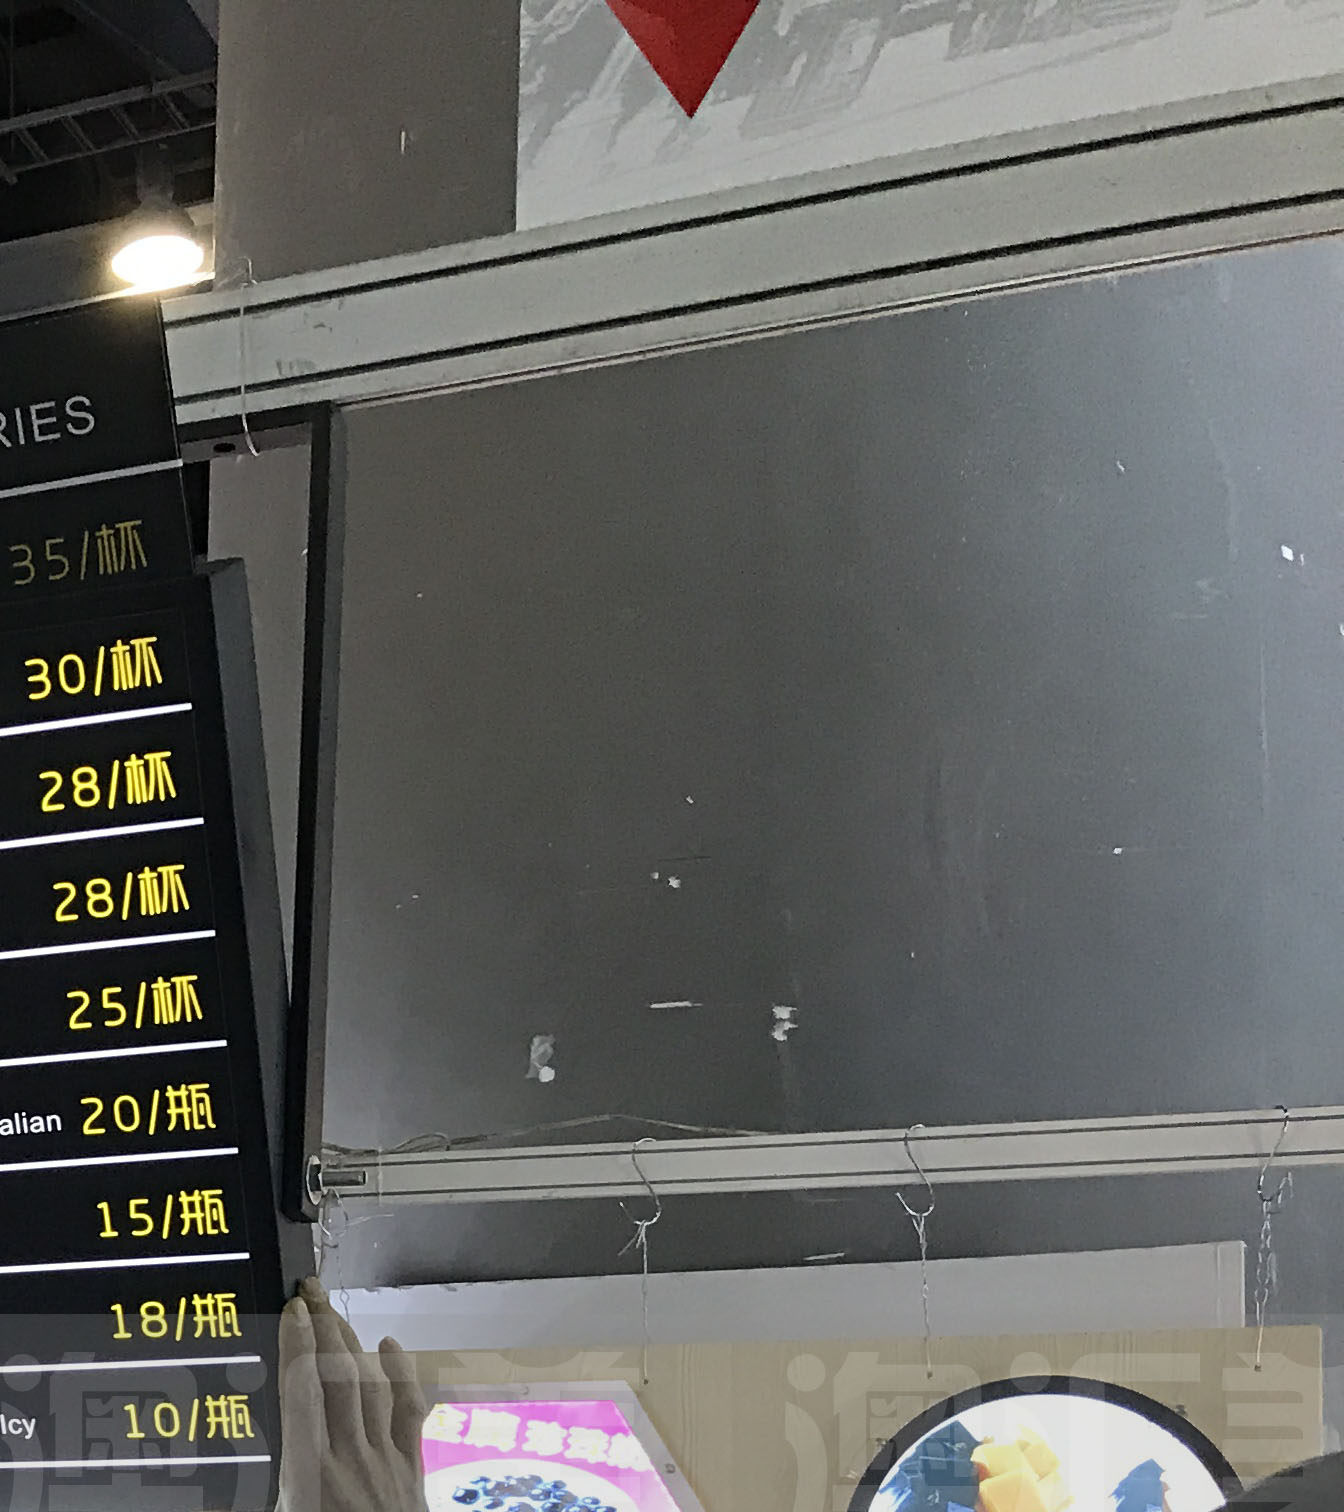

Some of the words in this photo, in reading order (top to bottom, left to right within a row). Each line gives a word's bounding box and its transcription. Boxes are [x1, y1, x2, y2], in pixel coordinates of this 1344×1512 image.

[8, 519, 149, 587] 35/杯
[25, 636, 164, 701] 30/杯
[39, 751, 177, 813] 28/杯
[53, 863, 191, 923] 28/杯
[67, 975, 205, 1032] 25/杯
[81, 1082, 218, 1137] 20/瓶
[96, 1190, 230, 1240] 15/瓶
[110, 1292, 244, 1341] 18/瓶
[0, 1412, 38, 1441] Icy
[124, 1394, 256, 1441] 10/瓶
